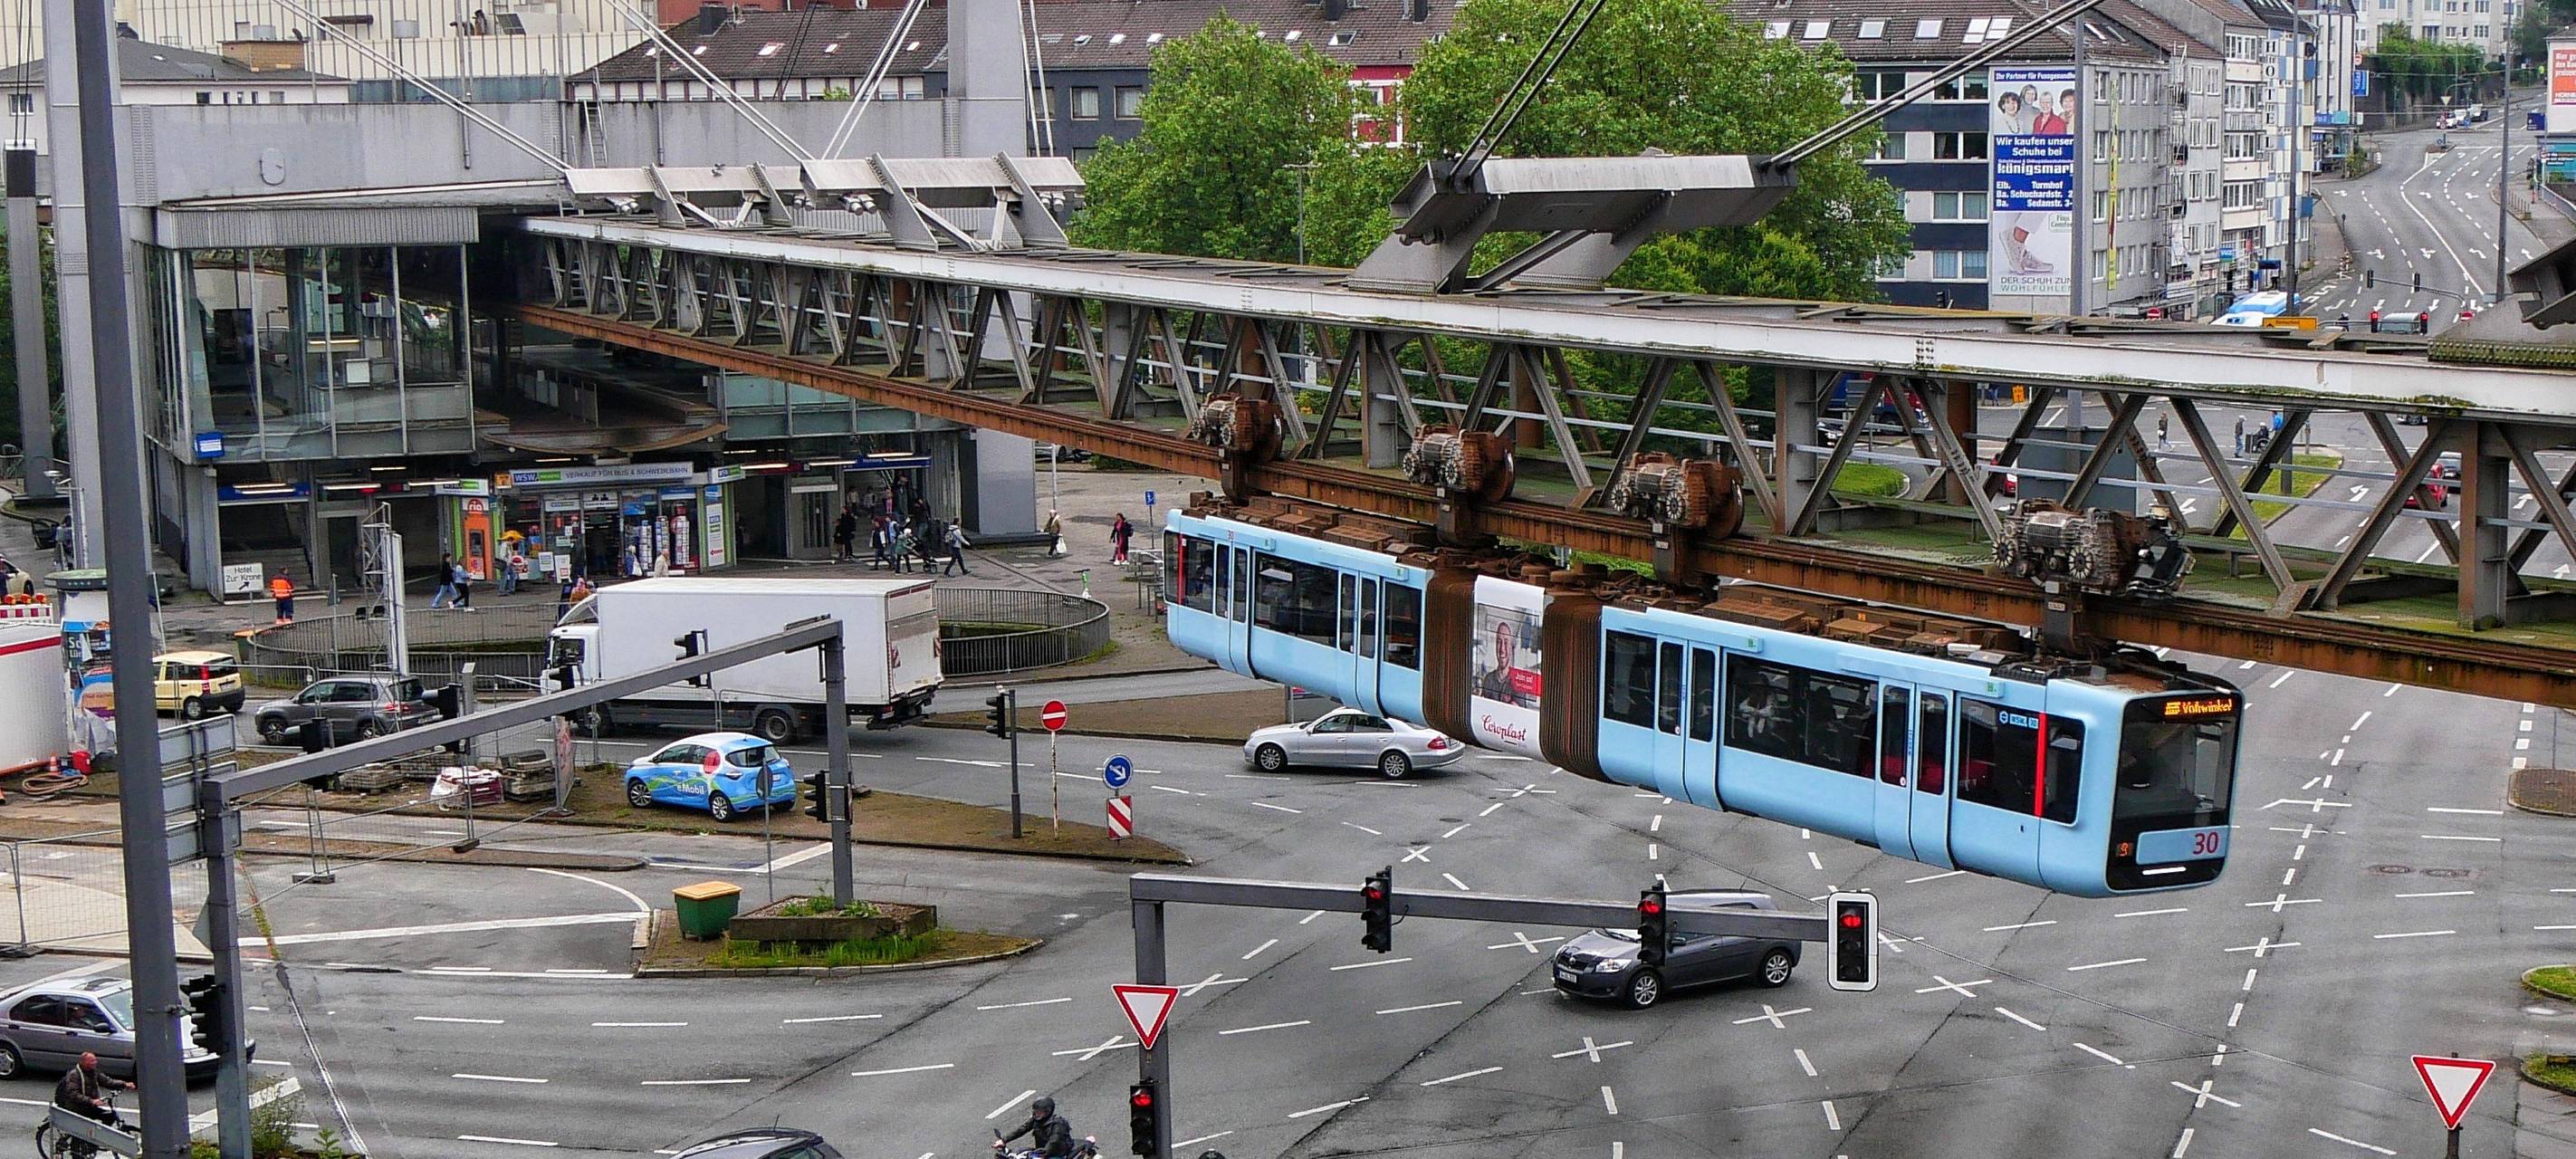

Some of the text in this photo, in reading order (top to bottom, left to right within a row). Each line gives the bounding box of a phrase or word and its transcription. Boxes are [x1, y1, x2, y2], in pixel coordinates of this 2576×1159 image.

[2037, 72, 2075, 81] Fussgesundh
[2265, 41, 2276, 149] HOTEL
[1996, 137, 2073, 146] Wir kaufen unser
[2012, 147, 2063, 157] Schuhe bei
[2031, 181, 2064, 189] Turmhof
[1997, 190, 2009, 198] Ba.
[2027, 199, 2063, 207] Sedanstr.
[2000, 276, 2018, 284] DER
[2021, 276, 2053, 284] SCHUH
[565, 469, 598, 479] VERKAUF
[225, 573, 262, 583] Zur Krone
[1481, 714, 1527, 742] Coroplast
[2192, 831, 2219, 856] 30
